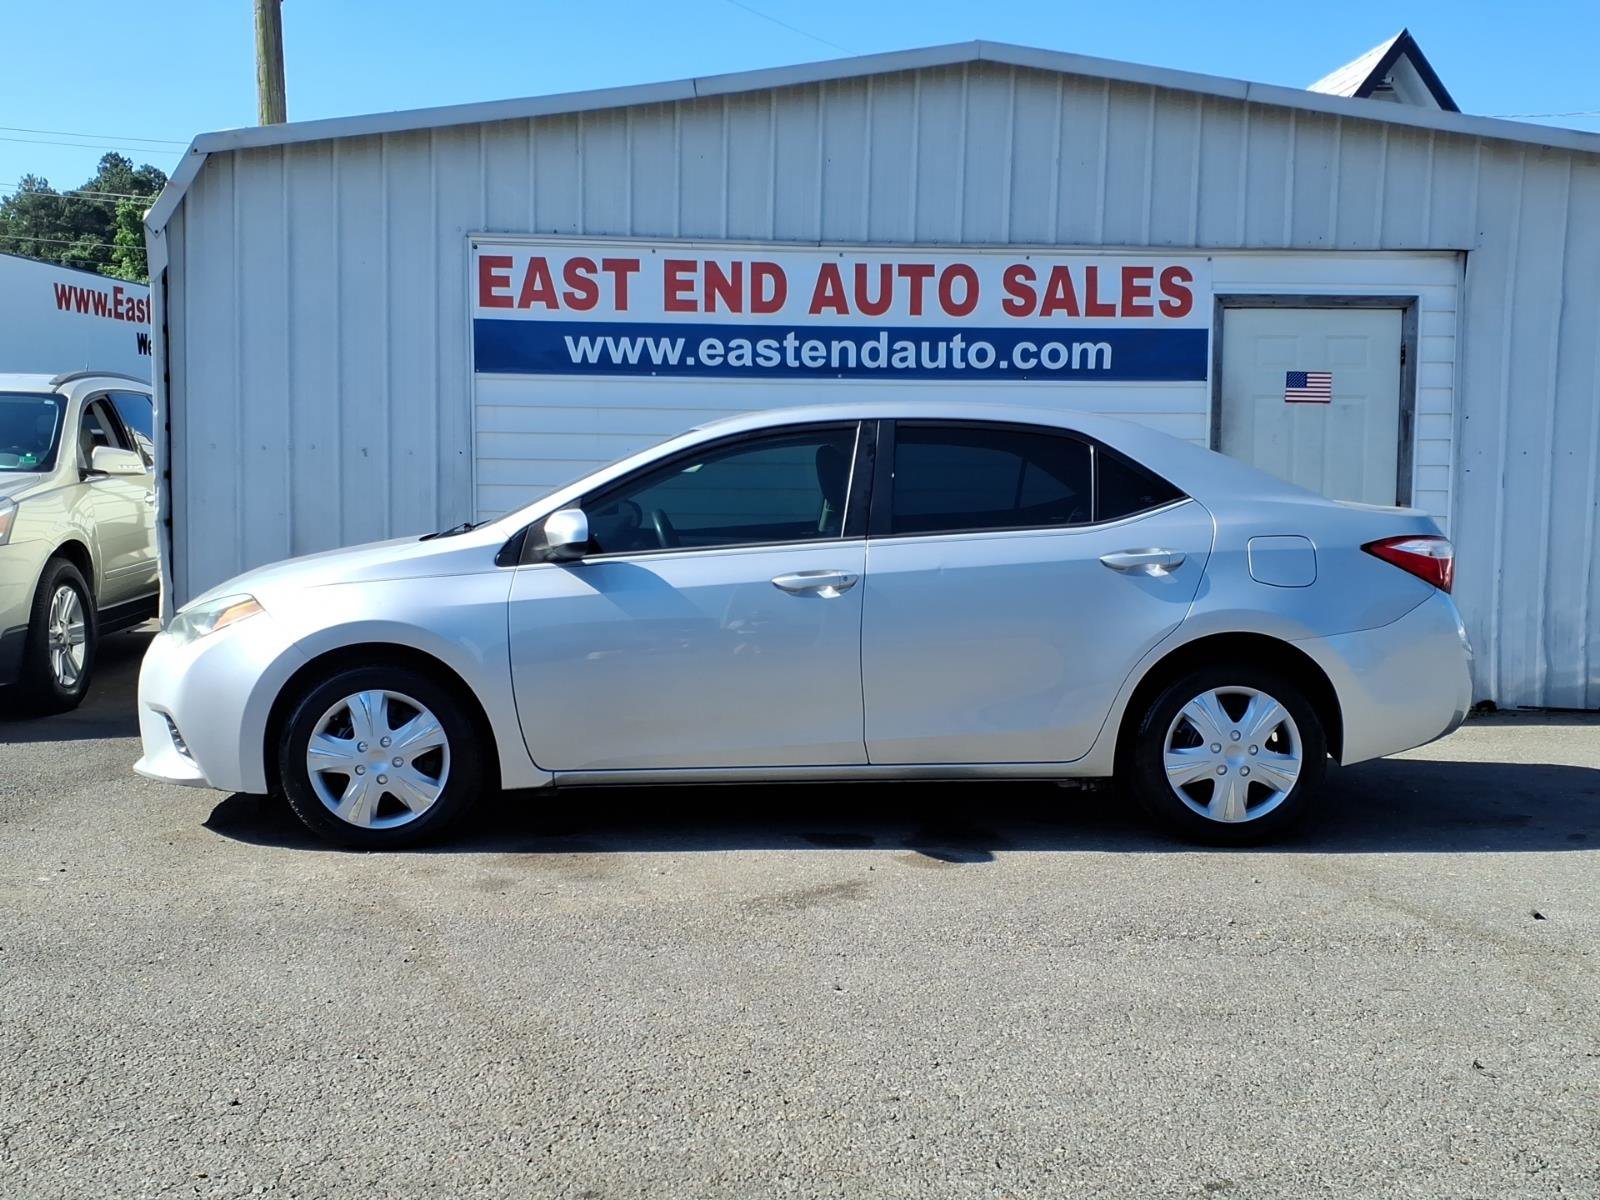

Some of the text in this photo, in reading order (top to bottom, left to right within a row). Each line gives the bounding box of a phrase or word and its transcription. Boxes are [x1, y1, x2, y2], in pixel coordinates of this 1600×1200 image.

[479, 255, 1194, 318] EAST END AUTO SALES
[564, 331, 1112, 369] www.eastendauto.com
